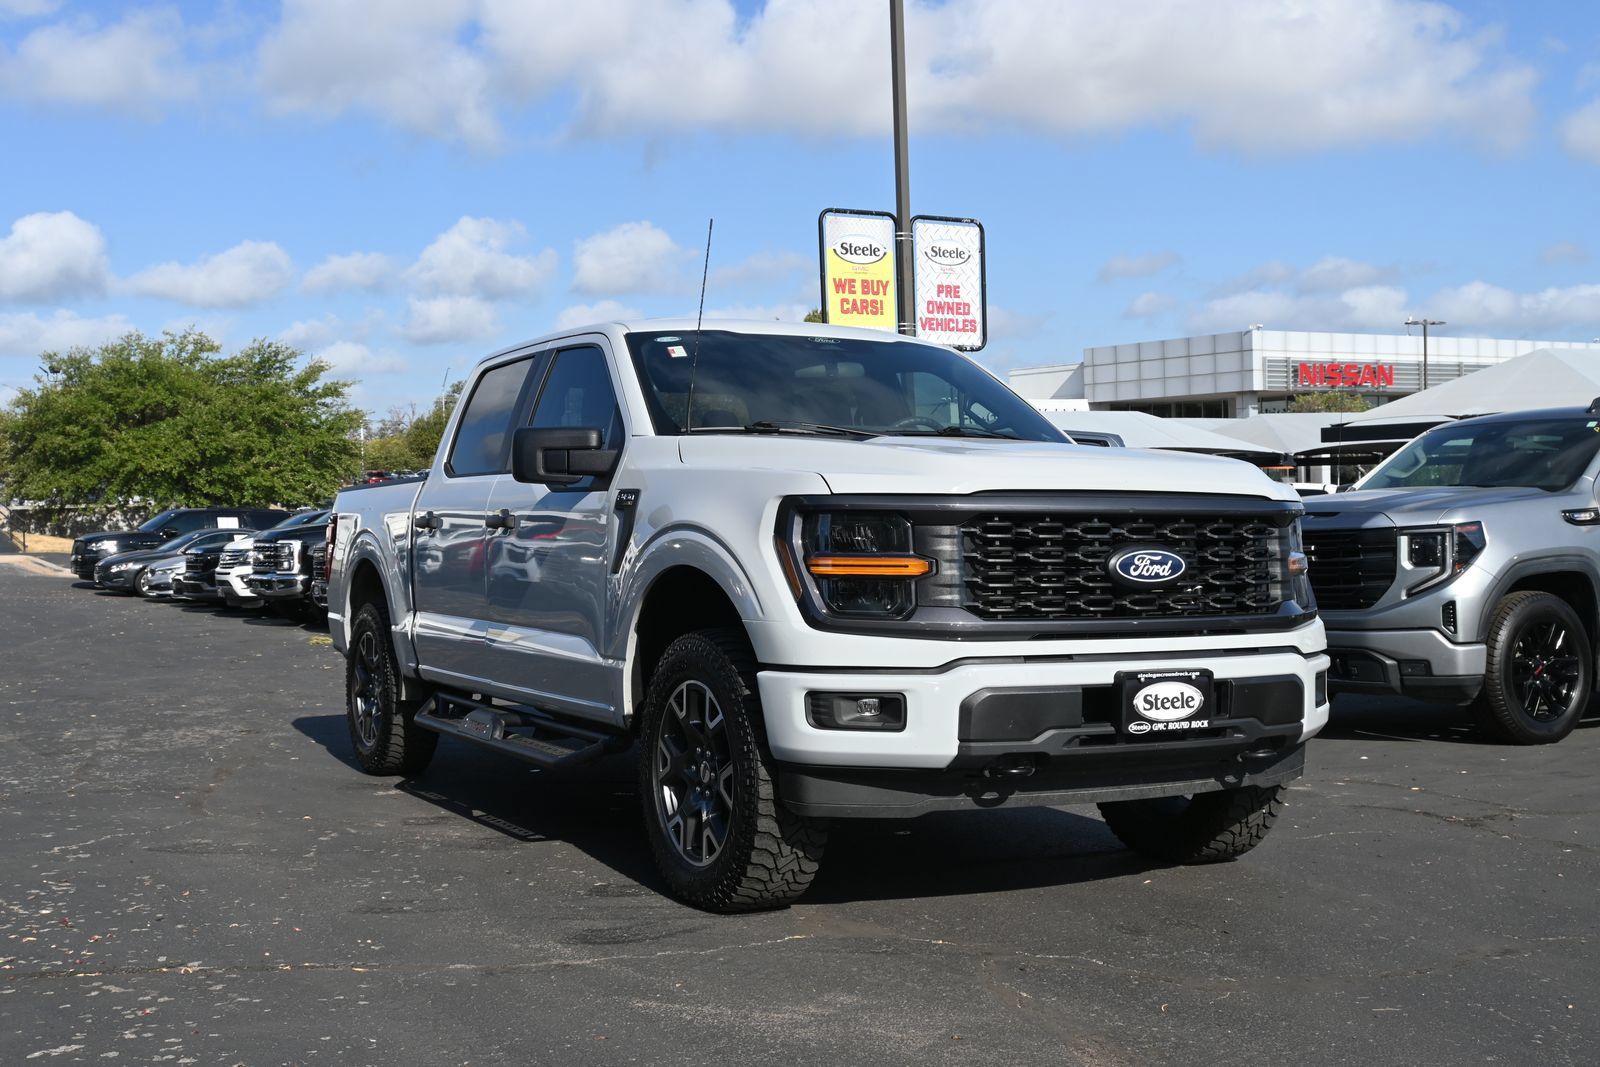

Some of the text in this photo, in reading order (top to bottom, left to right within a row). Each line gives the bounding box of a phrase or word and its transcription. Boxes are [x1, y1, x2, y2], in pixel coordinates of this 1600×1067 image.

[840, 242, 880, 257] Steele
[931, 246, 965, 259] Steele
[833, 278, 890, 296] WE BUY
[937, 284, 961, 299] PRE
[840, 297, 885, 315] CARS!
[926, 301, 971, 316] OWNED
[920, 317, 977, 333] VEHICLES
[1299, 362, 1394, 386] NISSAN
[1130, 554, 1173, 577] Ford
[1142, 691, 1195, 711] Steele
[1152, 722, 1167, 731] GMC
[1168, 721, 1190, 730] ROUND
[1191, 720, 1208, 729] ROCK
